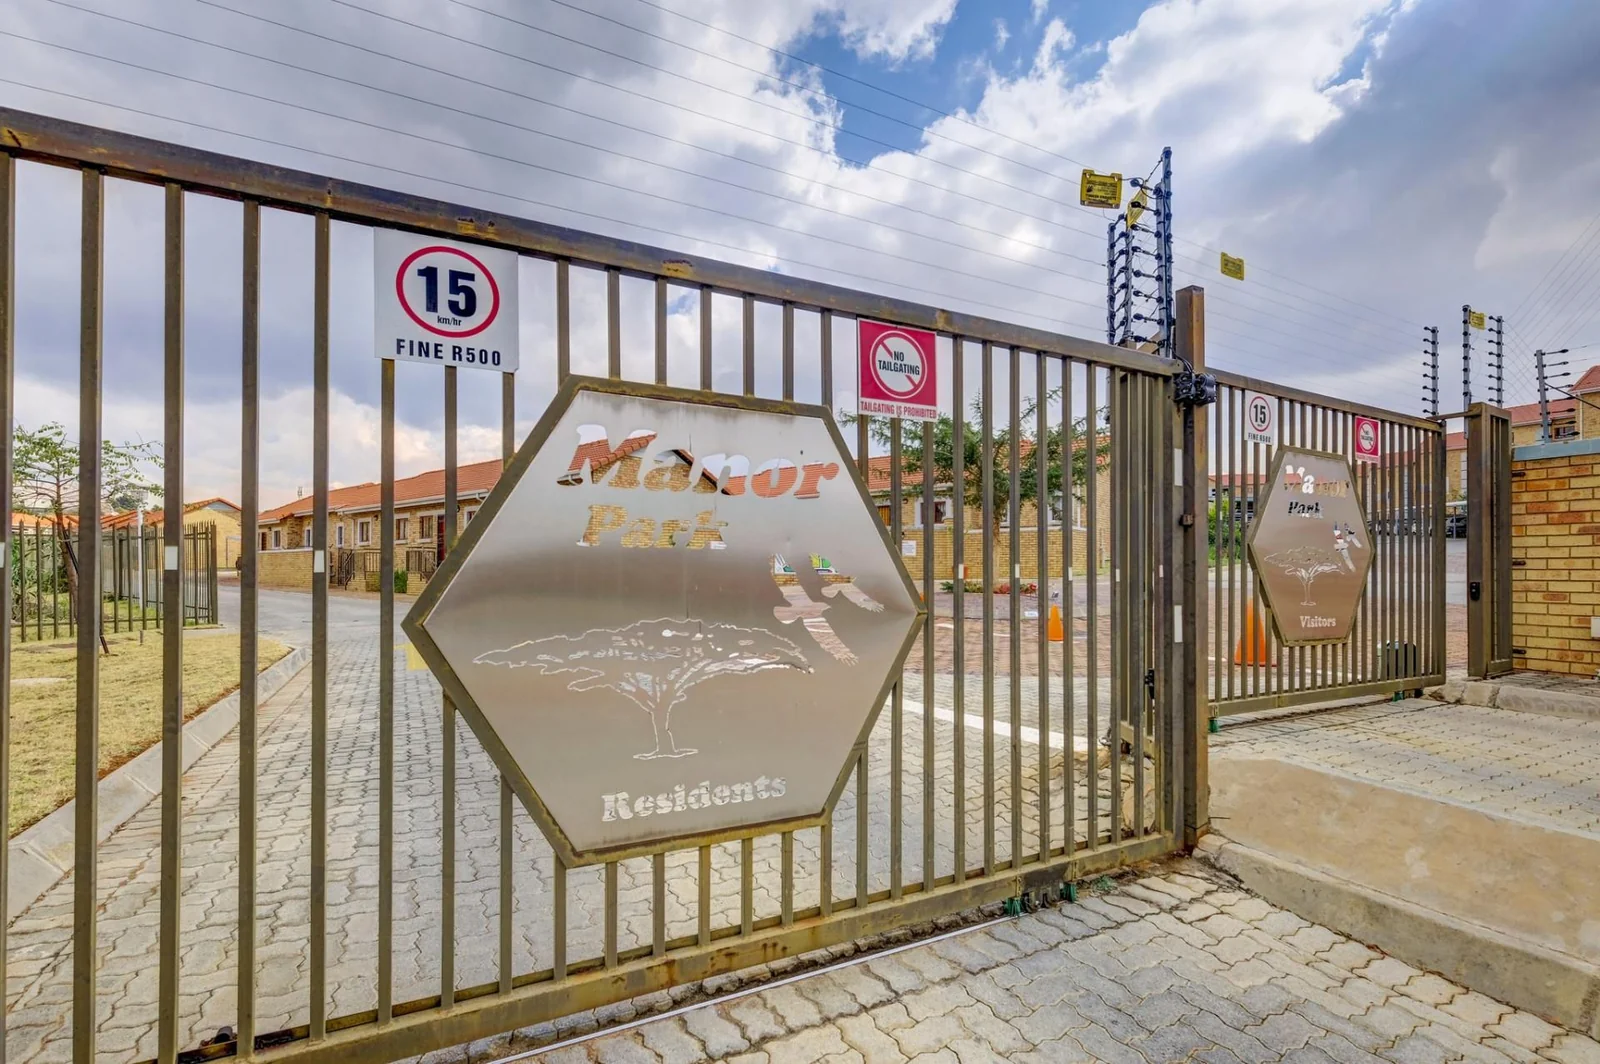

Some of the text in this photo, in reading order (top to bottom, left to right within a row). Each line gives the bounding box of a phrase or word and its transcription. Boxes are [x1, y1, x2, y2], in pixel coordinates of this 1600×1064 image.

[417, 265, 477, 318] 15
[437, 315, 462, 327] km/hr
[396, 338, 501, 366] FINE R500
[893, 351, 904, 361] NO
[878, 359, 920, 375] TAILGATING
[861, 401, 895, 414] TAILGATING
[903, 406, 937, 419] PROHIBITED
[1253, 403, 1267, 424] 15
[556, 424, 839, 499] Manor
[576, 504, 728, 550] Park
[1300, 615, 1336, 628] Visitors
[602, 775, 787, 822] Residents
